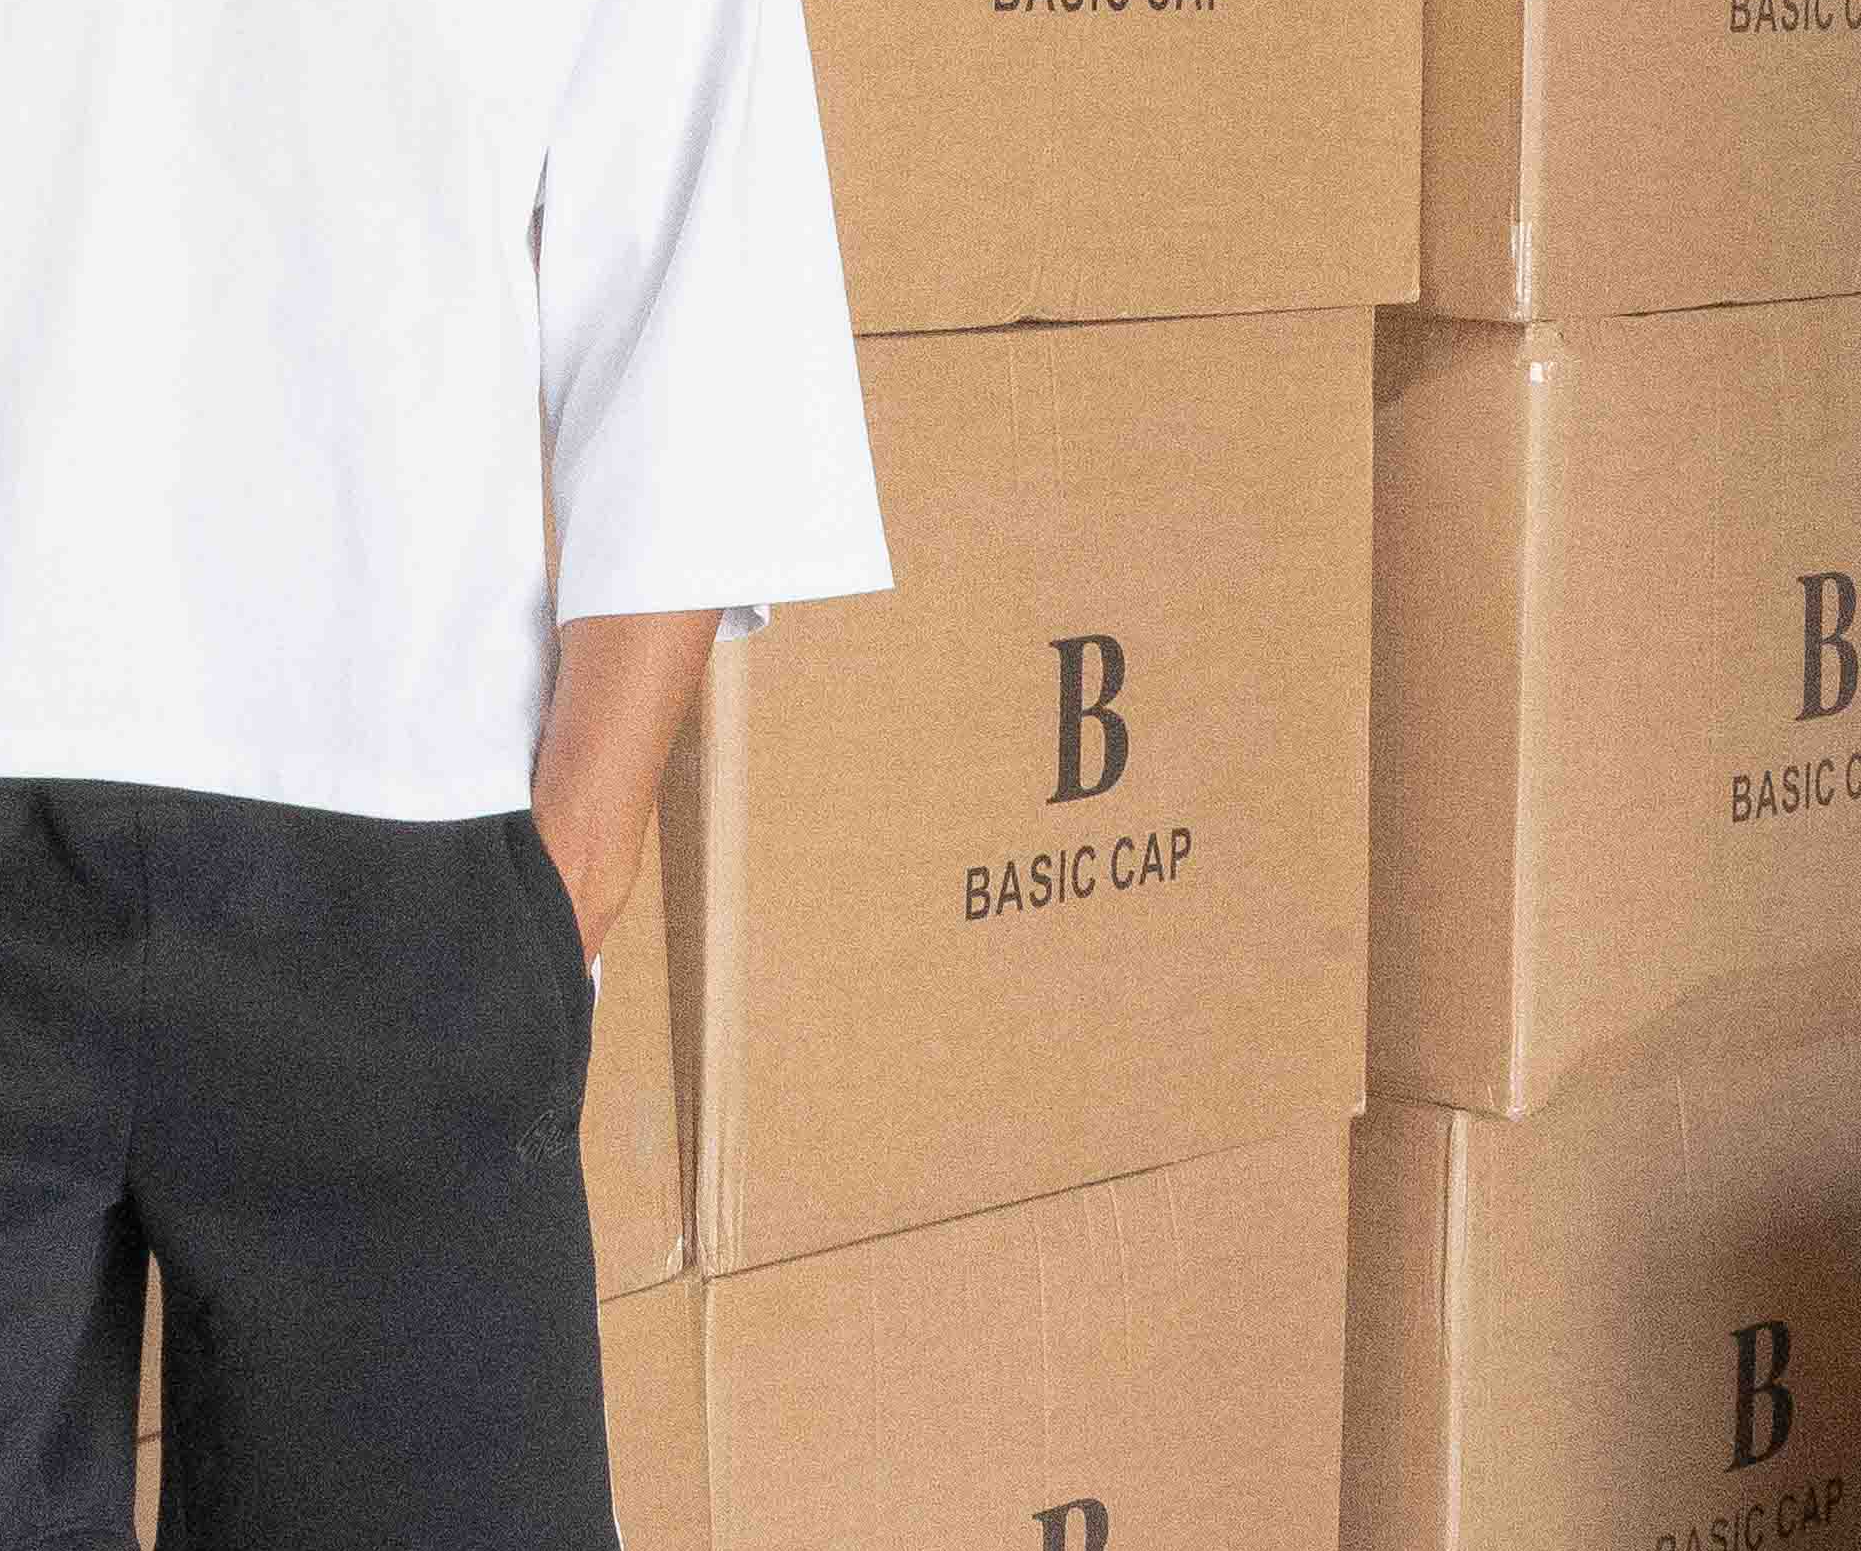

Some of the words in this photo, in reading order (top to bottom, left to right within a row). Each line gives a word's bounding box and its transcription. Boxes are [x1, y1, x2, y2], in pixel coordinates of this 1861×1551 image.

[1795, 571, 1859, 722] B
[1046, 634, 1129, 805] B
[1731, 758, 1835, 823] BASIC
[965, 845, 1097, 921] BASIC
[1110, 827, 1191, 890] CAP
[1724, 1320, 1795, 1474] B
[1777, 1476, 1844, 1539] CAP
